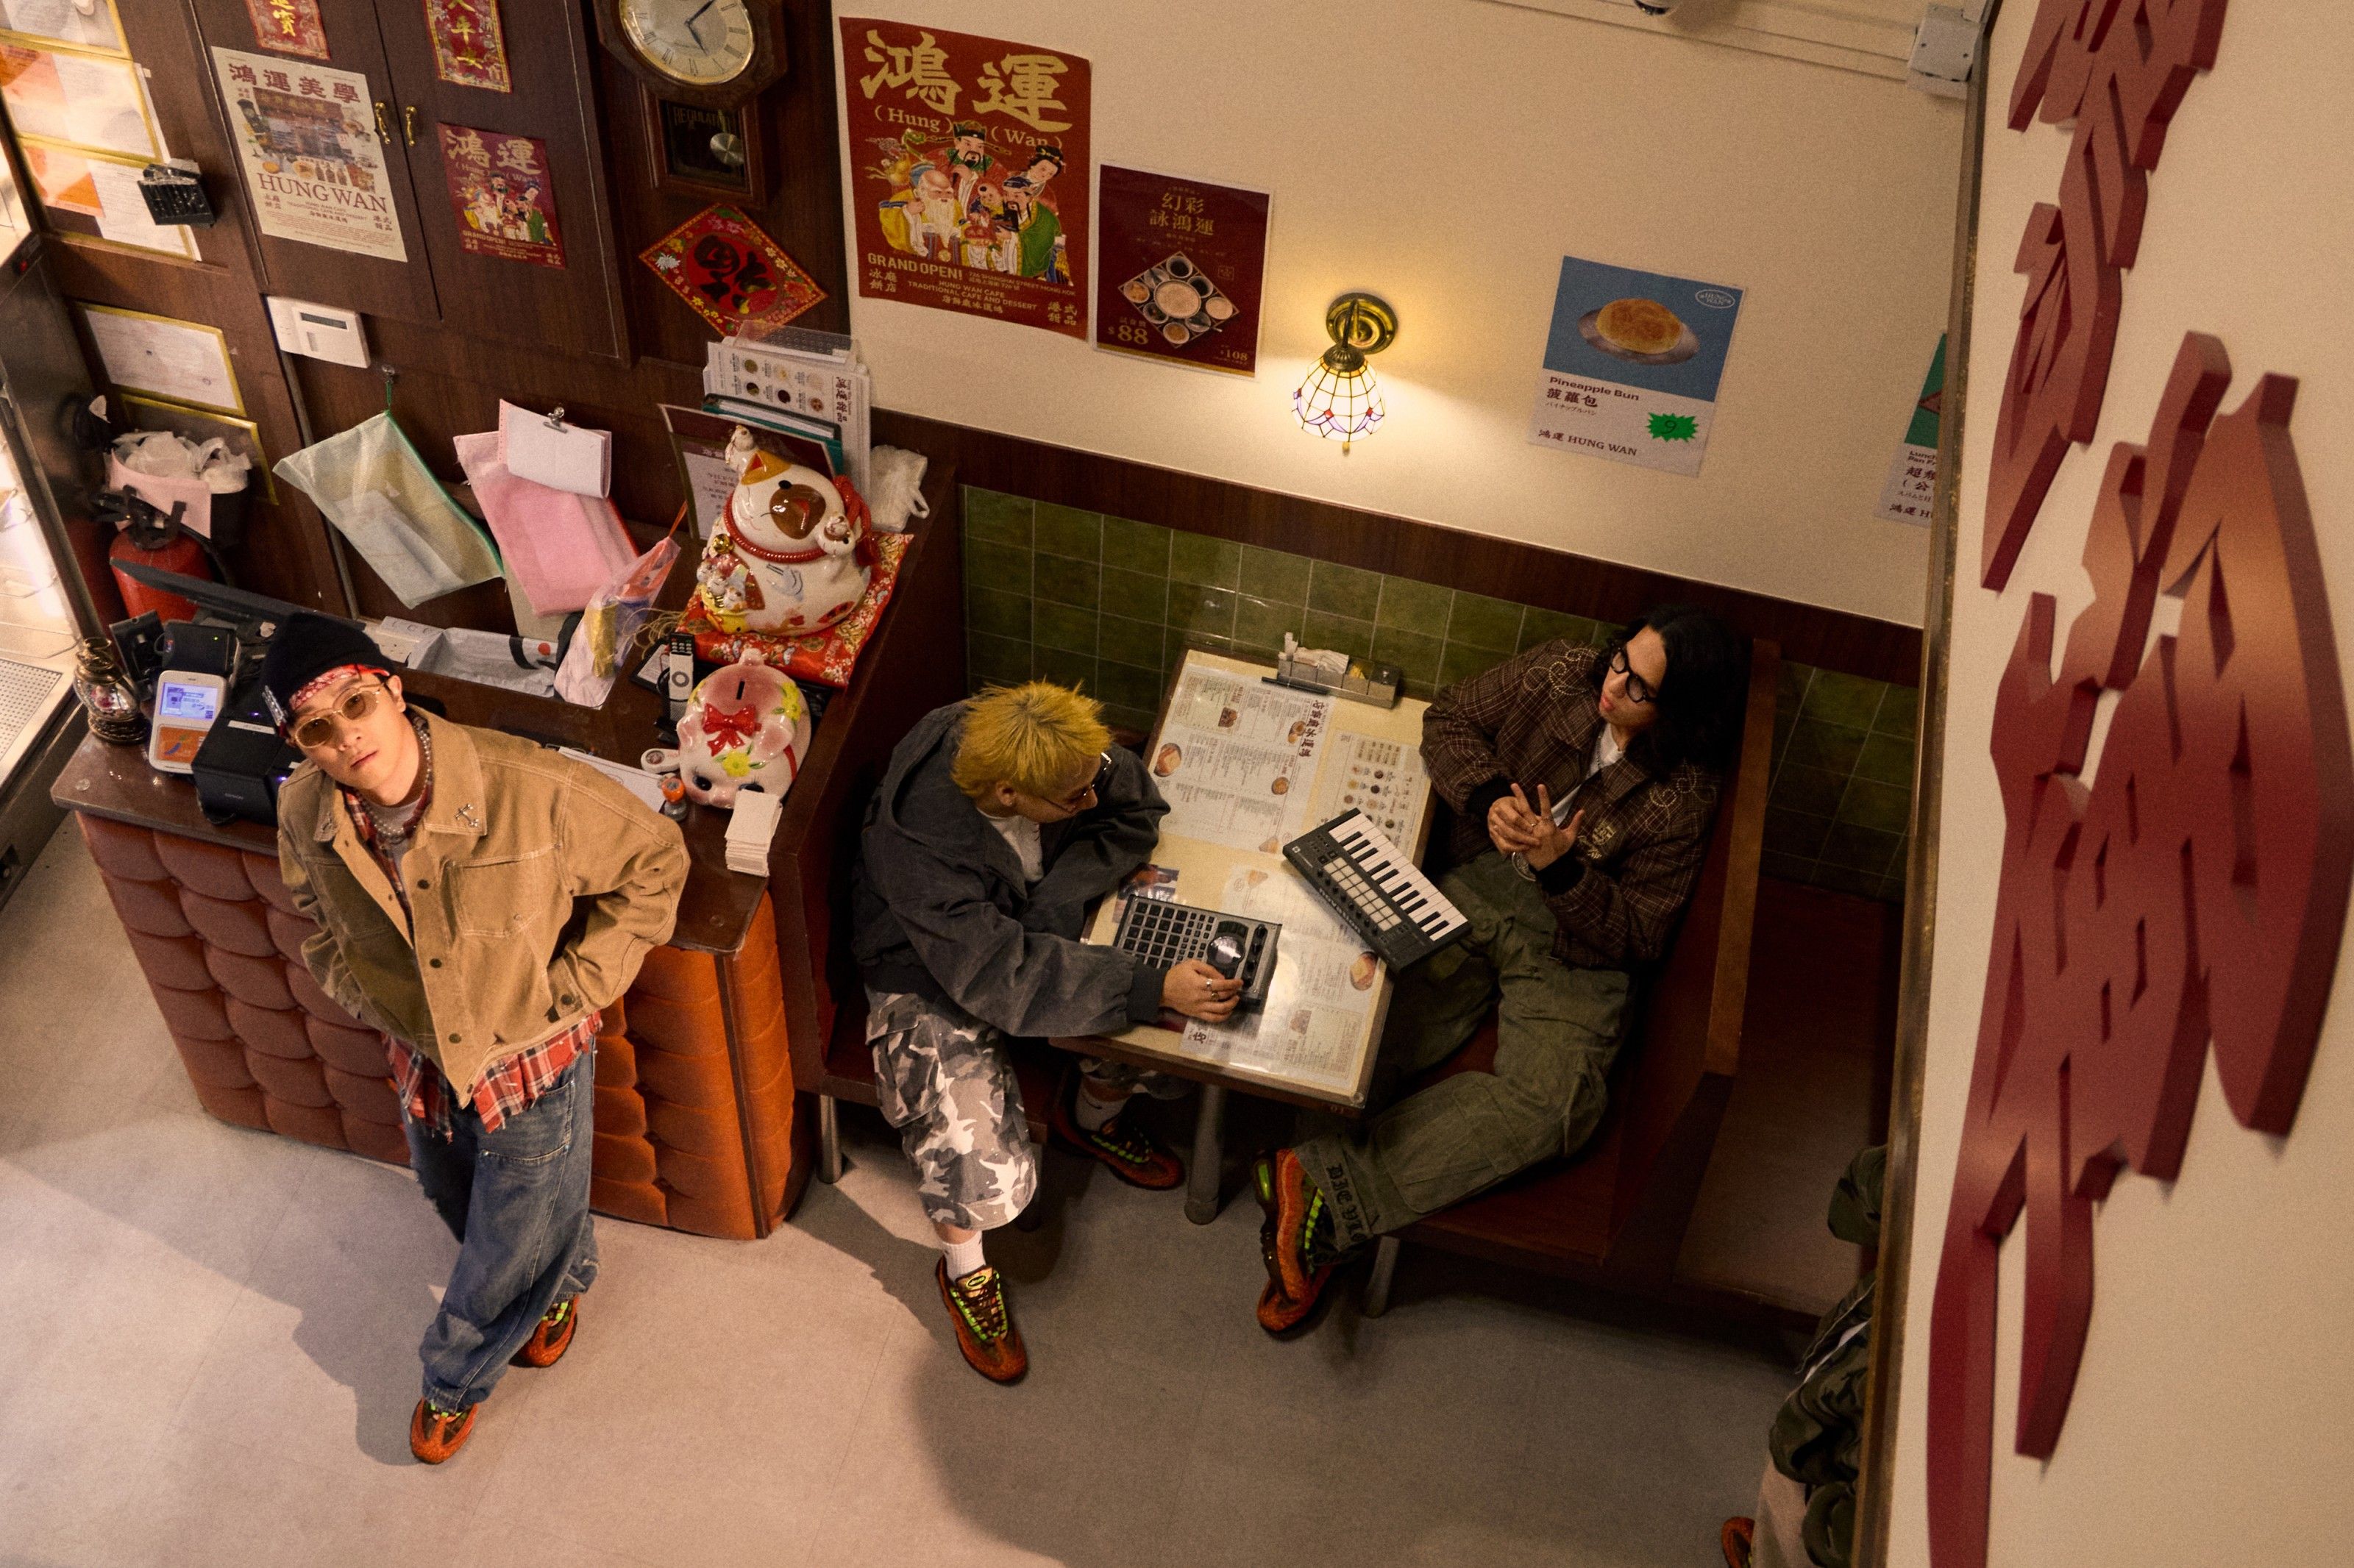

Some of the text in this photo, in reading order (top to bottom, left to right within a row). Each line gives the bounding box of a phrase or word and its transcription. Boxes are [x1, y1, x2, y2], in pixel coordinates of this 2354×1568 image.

[229, 63, 360, 104] 鴻運美學
[860, 29, 1073, 133] 鴻運
[446, 129, 542, 176] 鴻運
[257, 173, 388, 214] HUNG WAN
[1162, 192, 1204, 215] 幻彩
[1149, 209, 1214, 236] 詠鴻運
[868, 252, 963, 281] GRAND OPEN!
[1546, 388, 1598, 408] 菠蘿包
[1549, 377, 1640, 401] Pineapple Bun
[1660, 420, 1677, 434] 9
[1538, 429, 1638, 457] 鴻運 HUNG WAN
[1318, 887, 1362, 936] novation
